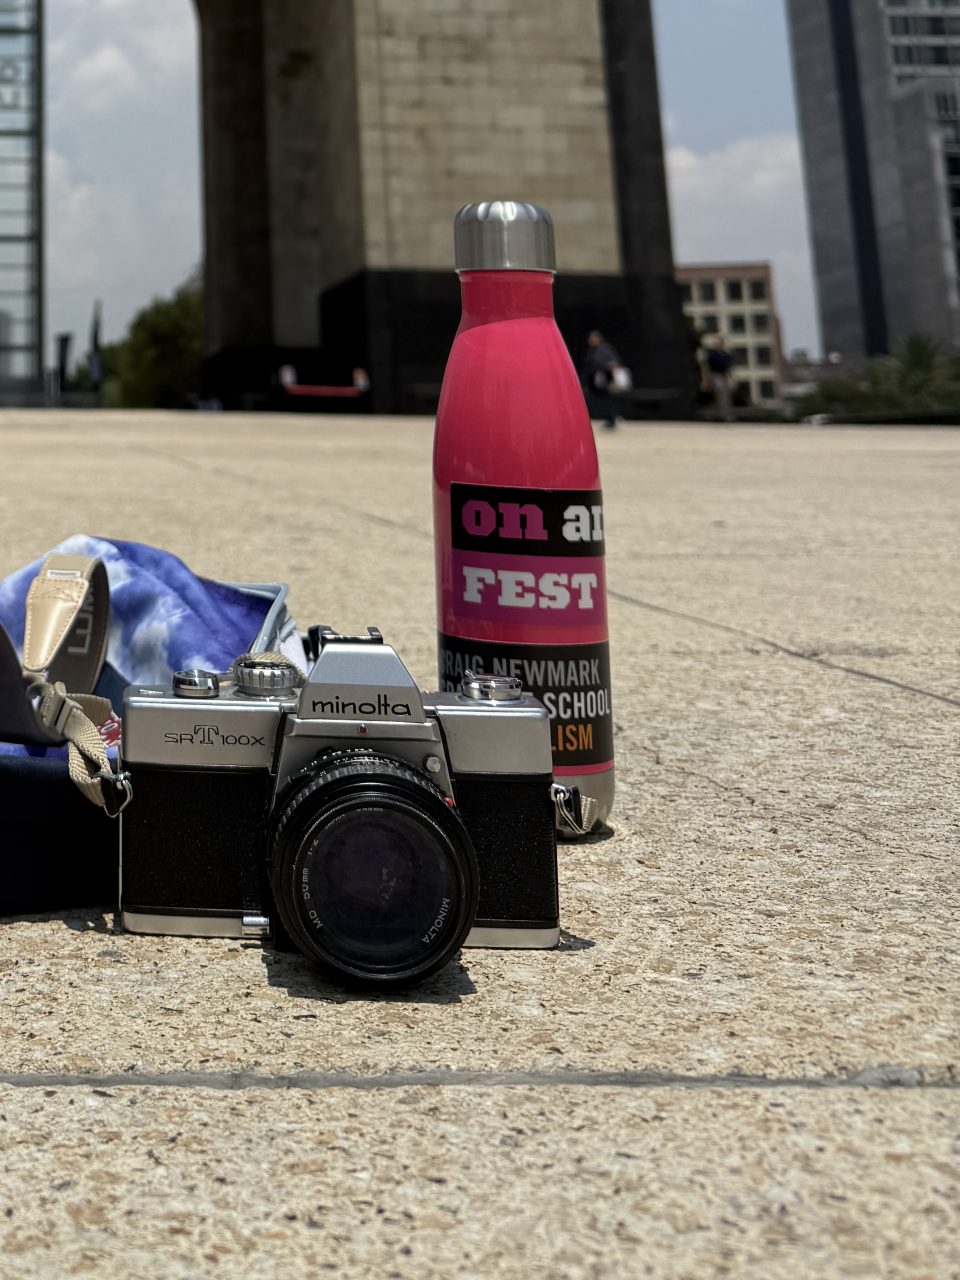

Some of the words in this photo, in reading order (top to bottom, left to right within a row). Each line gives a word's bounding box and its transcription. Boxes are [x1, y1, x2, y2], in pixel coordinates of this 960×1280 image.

[462, 499, 548, 541] on
[462, 565, 598, 609] FEST
[492, 656, 601, 688] NEWMARK
[312, 694, 412, 717] minolta
[542, 688, 610, 719] SCHOOL
[308, 910, 324, 930] MD
[421, 897, 451, 944] MINOLTA
